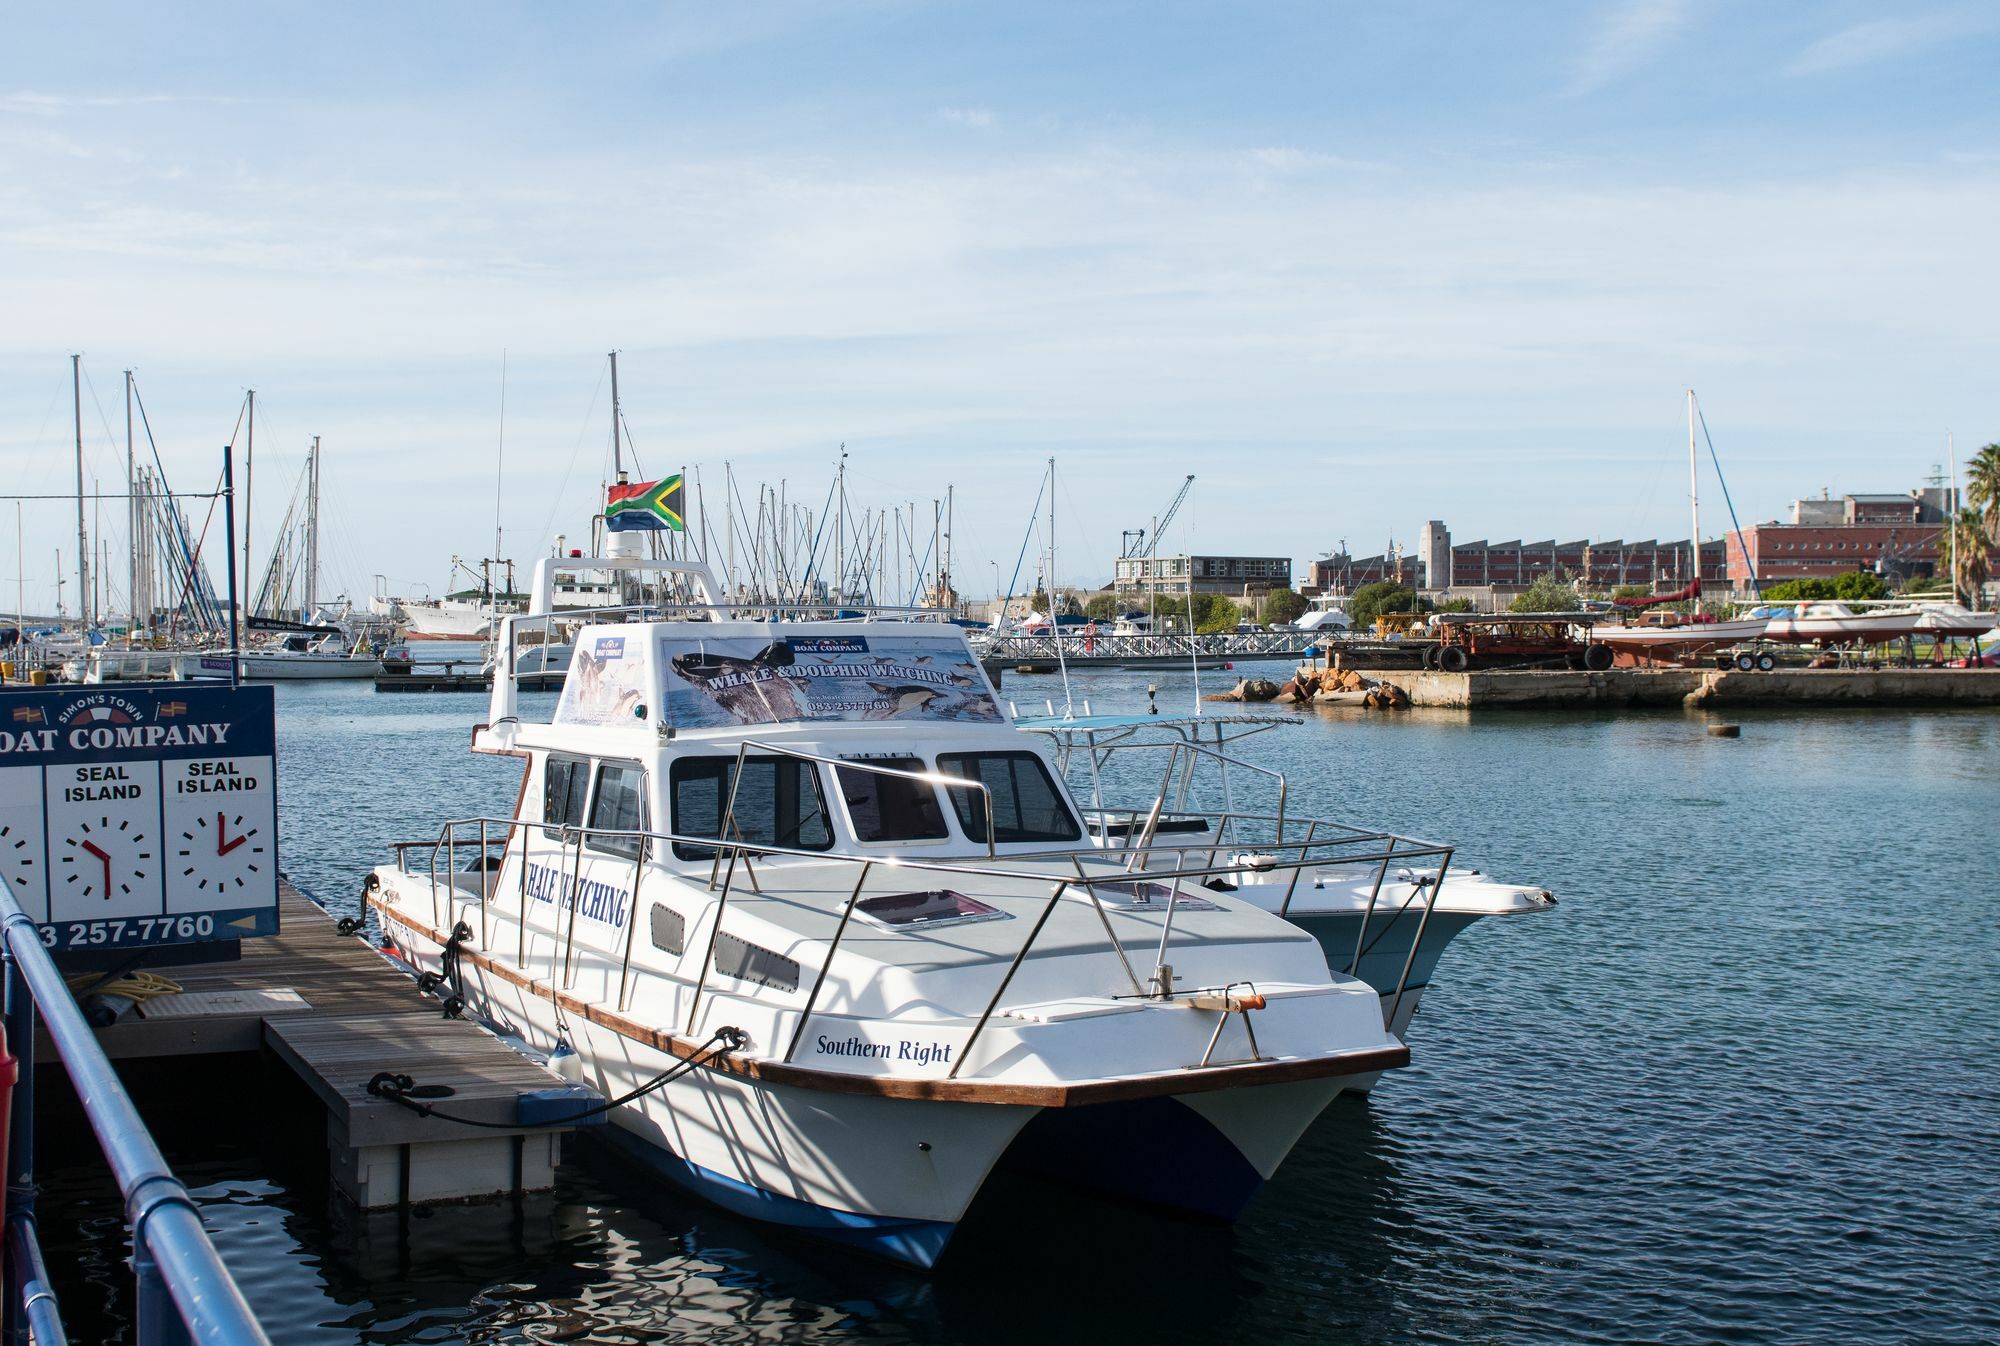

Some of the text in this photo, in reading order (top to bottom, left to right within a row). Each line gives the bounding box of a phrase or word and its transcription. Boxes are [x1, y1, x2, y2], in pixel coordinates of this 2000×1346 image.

[707, 664, 954, 691] WHALE & DOLPHIN WATCHING
[59, 695, 143, 724] SIMON'S TOWN
[808, 701, 890, 711] 083 2577760
[0, 723, 231, 753] OAT COMPANY
[76, 765, 129, 782] SEAL
[188, 761, 240, 776] SEAL
[65, 785, 142, 802] ISLAND
[177, 777, 257, 794] ISLAND
[69, 914, 214, 946] 257-7760
[816, 1035, 953, 1067] Southern Right
